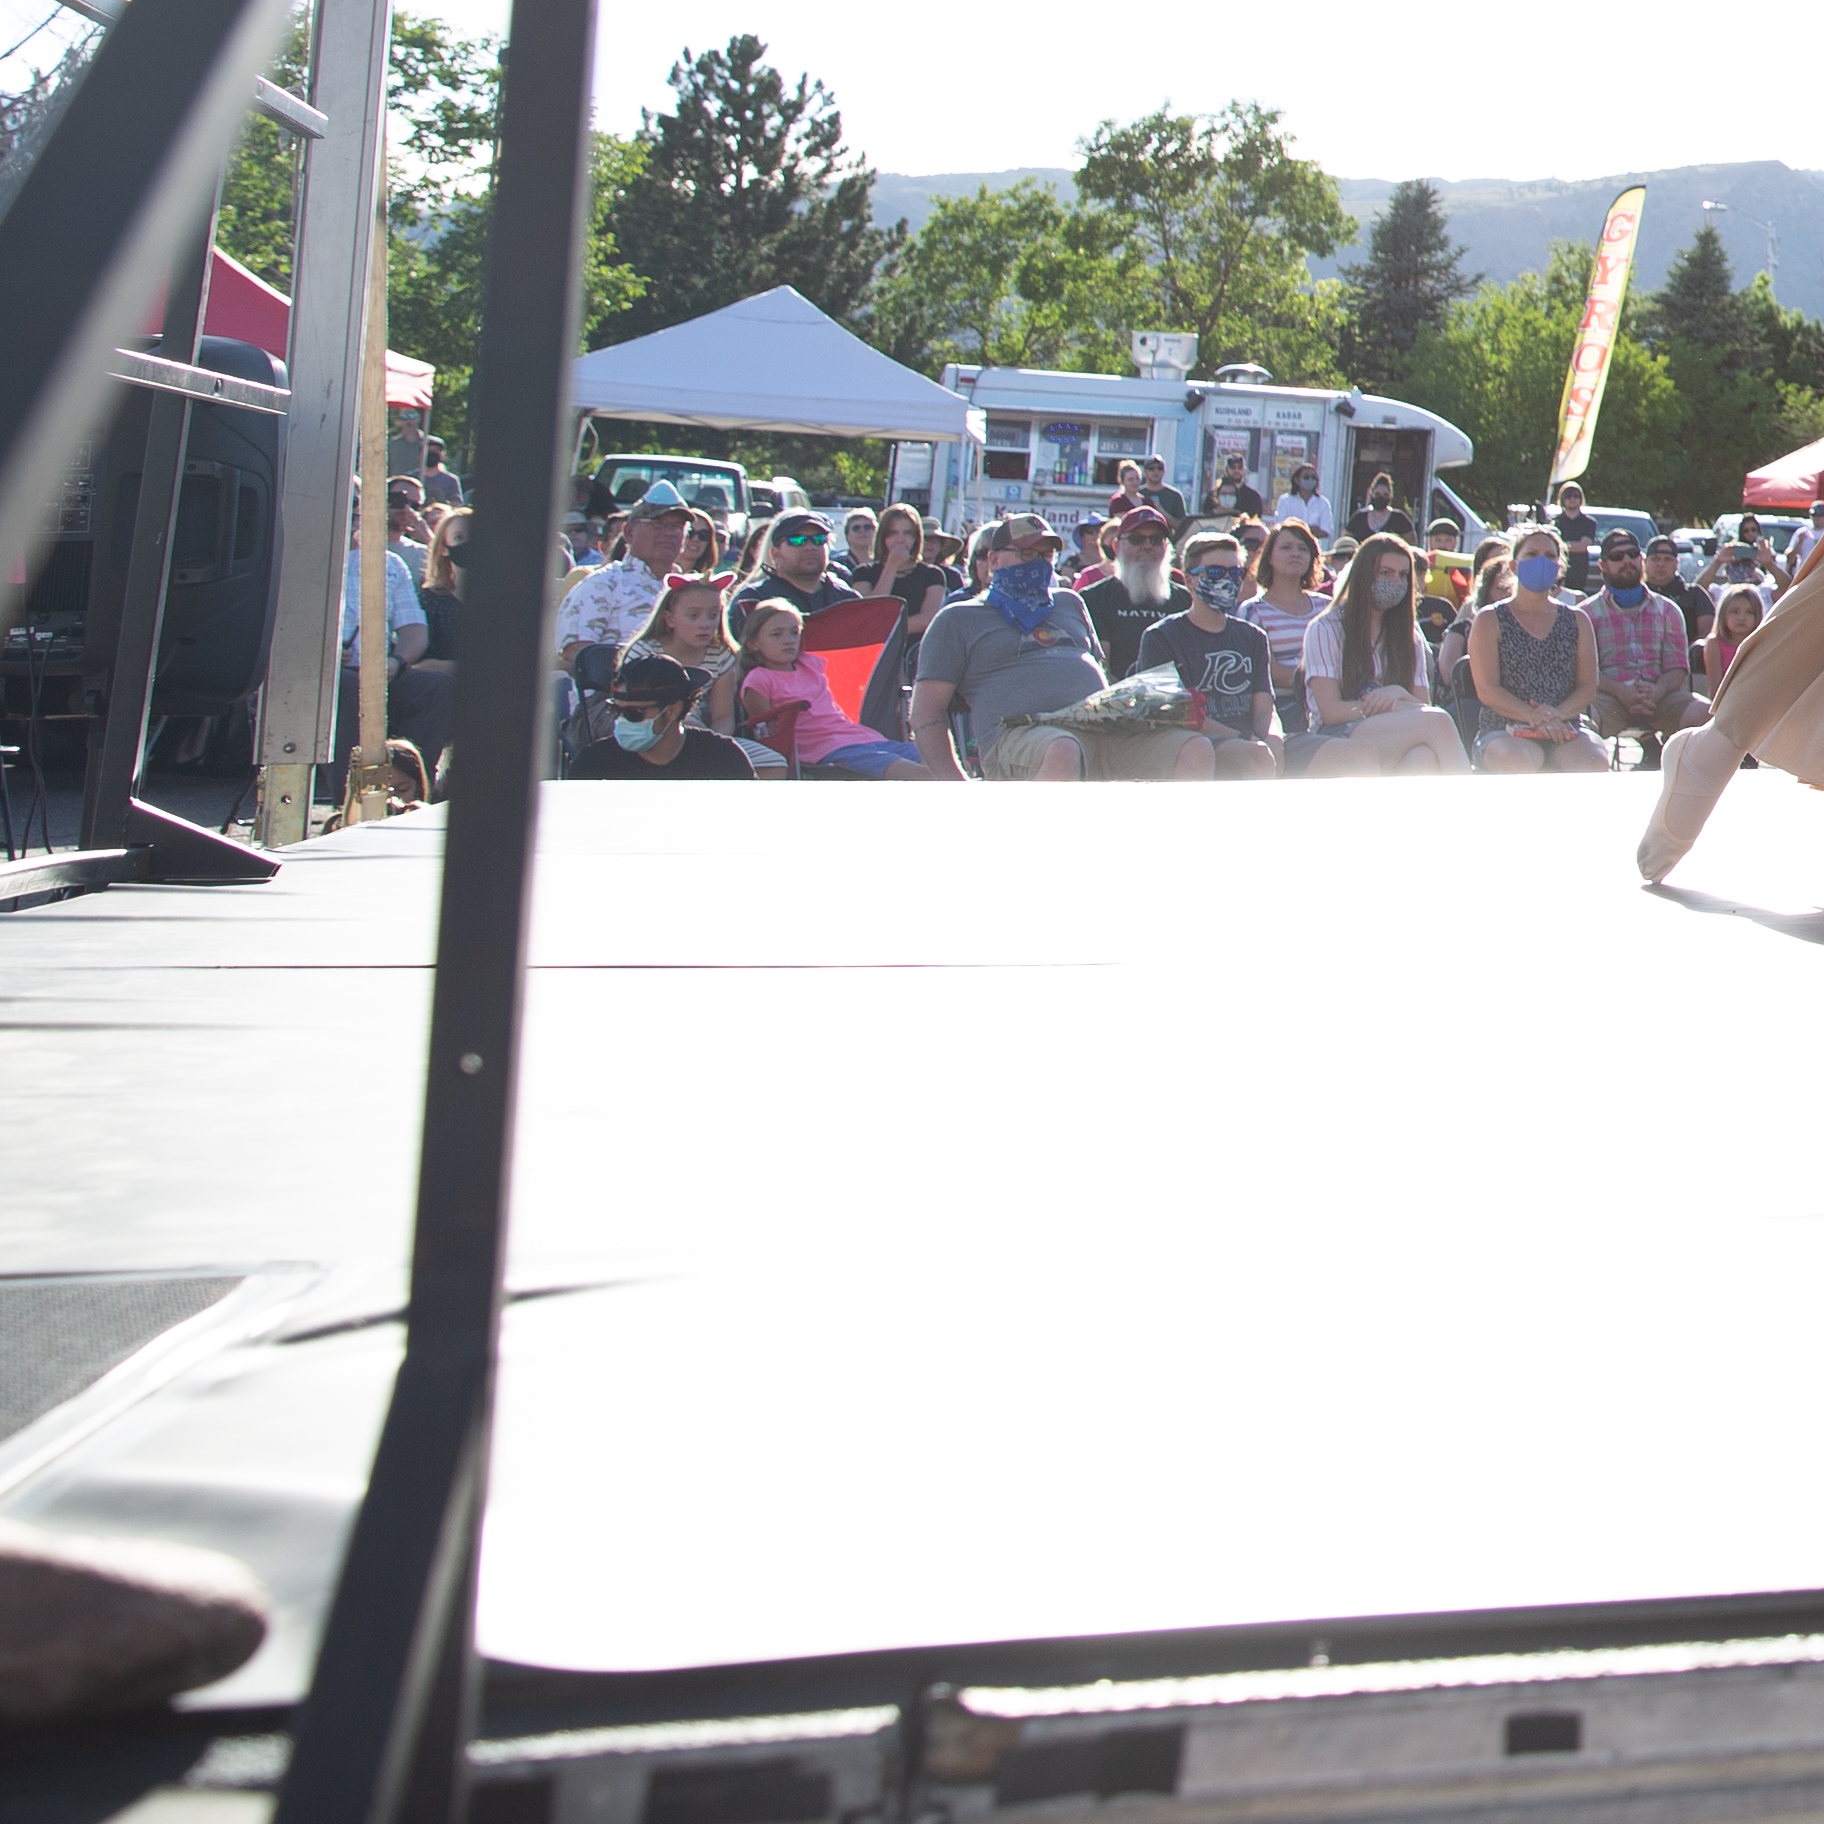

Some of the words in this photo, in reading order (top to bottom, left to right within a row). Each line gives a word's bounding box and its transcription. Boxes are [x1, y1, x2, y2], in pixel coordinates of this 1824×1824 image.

[994, 504, 1080, 525] Khland
[1117, 609, 1168, 617] NATIV
[1196, 650, 1252, 694] PC
